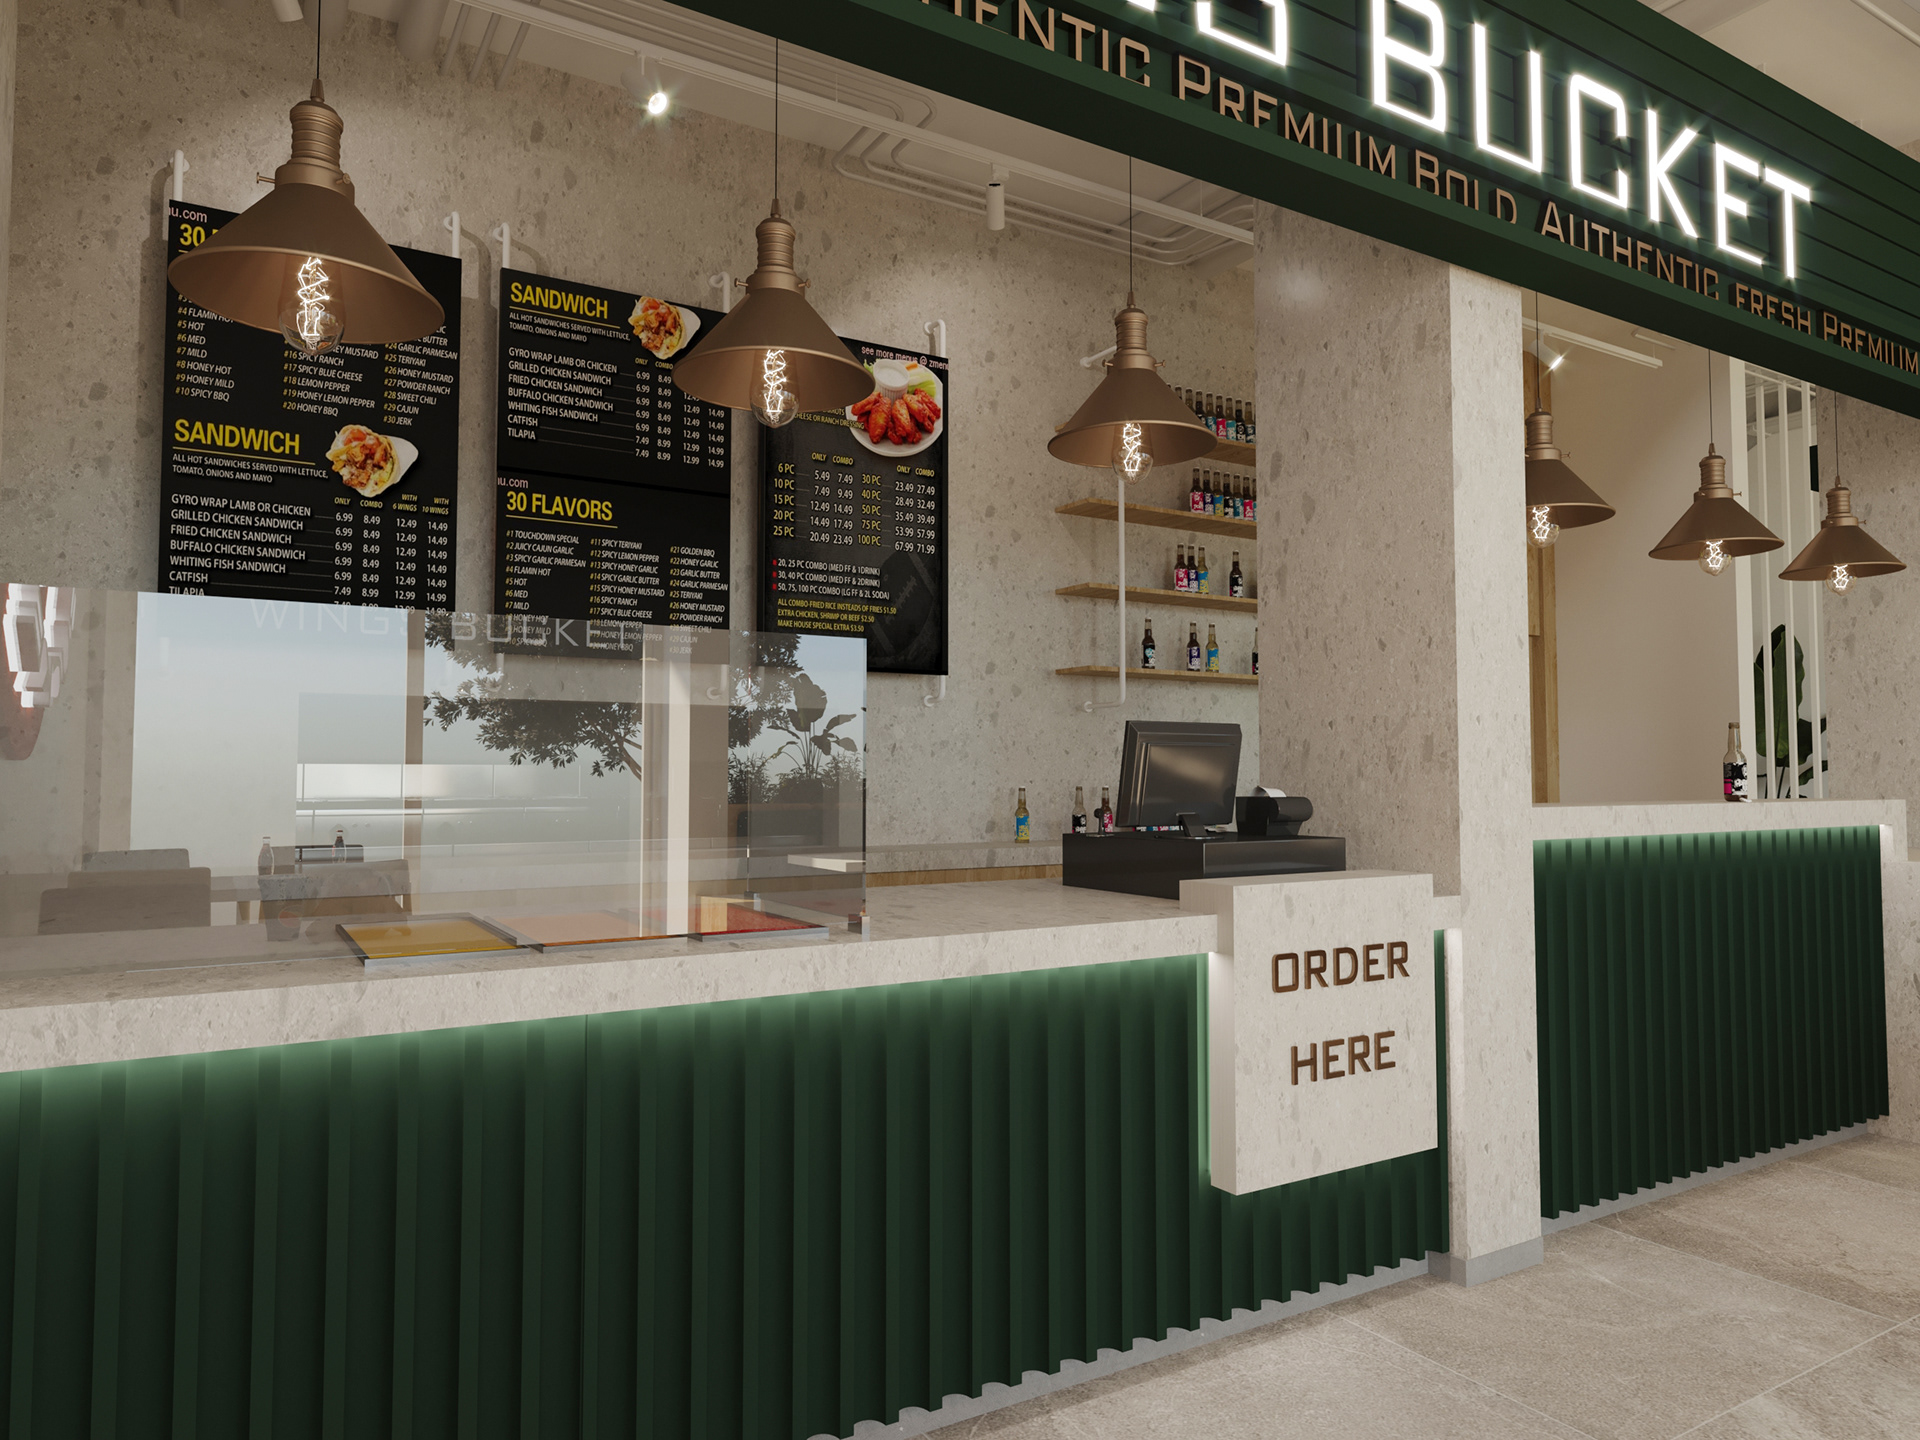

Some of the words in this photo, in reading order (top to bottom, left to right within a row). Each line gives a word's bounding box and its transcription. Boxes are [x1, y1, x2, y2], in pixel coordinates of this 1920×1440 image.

[1370, 0, 1812, 280] BUCKET
[180, 223, 206, 247] 30
[1540, 200, 1720, 301] AUTHENTIC
[1735, 281, 1812, 336] FRESH
[510, 282, 608, 319] SANDWICH
[176, 346, 187, 355] #7
[186, 347, 208, 359] MILD
[508, 346, 530, 359] GYRO
[530, 350, 553, 362] WRAP
[553, 355, 574, 366] LAMB
[575, 358, 586, 368] OR
[586, 360, 617, 373] CHICKEN
[861, 346, 875, 356] see
[876, 348, 894, 360] more
[176, 360, 186, 369] #8
[186, 361, 215, 372] HONEY
[214, 365, 232, 375] HOT
[508, 360, 540, 374] GRILLED
[540, 365, 572, 379] CHICKEN
[572, 371, 612, 385] SANDWICH
[176, 373, 186, 382] #9
[186, 374, 214, 386] HONEY
[214, 378, 235, 389] MILD
[508, 373, 530, 385] FRIED
[530, 377, 563, 391] CHICKEN
[563, 382, 603, 397] SANDWICH
[175, 387, 190, 396] #10
[190, 387, 213, 399] SPICY
[213, 391, 230, 402] BBQ
[507, 414, 538, 427] CATFISH
[174, 419, 300, 455] SANDWICH
[507, 427, 536, 440] TILAPIA
[811, 452, 827, 461] ONLY
[832, 455, 854, 466] COMBO
[778, 463, 784, 473] 6
[784, 463, 795, 475] PC
[814, 470, 830, 481] 5.49
[838, 473, 853, 484] 7.49
[896, 464, 911, 474] ONLY
[915, 467, 935, 477] COMBO
[774, 478, 784, 489] 10
[784, 479, 795, 490] PC
[814, 485, 830, 497] 7.49
[837, 488, 853, 500] 9.49
[862, 473, 871, 484] 30
[871, 475, 881, 486] PC
[895, 481, 914, 493] 23.49
[917, 484, 935, 496] 27.49
[334, 496, 351, 505] ONLY
[359, 499, 383, 509] COMBO
[397, 503, 417, 512] WINGS
[401, 494, 418, 502] WITH
[434, 497, 450, 505] WITH
[506, 490, 527, 512] 30
[532, 493, 613, 521] FLAVORS
[774, 494, 783, 504] 15
[784, 494, 795, 506] PC
[810, 500, 830, 512] 12.49
[834, 503, 853, 515] 14.49
[861, 489, 871, 499] 40
[871, 490, 881, 501] PC
[895, 496, 914, 508] 28.49
[917, 499, 935, 510] 32.49
[171, 493, 199, 506] GYRO
[199, 496, 228, 508] WRAP
[229, 499, 256, 511] LAMB
[257, 502, 271, 513] OR
[272, 503, 311, 516] CHICKEN
[335, 512, 353, 522] 6.99
[363, 514, 381, 525] 8.49
[396, 518, 417, 529] 12.49
[428, 521, 448, 532] 14.49
[429, 506, 449, 515] WINGS
[773, 509, 783, 520] 20
[784, 510, 794, 522] PC
[810, 516, 830, 528] 14.49
[834, 519, 853, 530] 17.49
[862, 504, 871, 514] 50
[871, 505, 881, 516] PC
[895, 511, 914, 522] 35.49
[917, 513, 935, 525] 39.49
[171, 508, 211, 522] GRILLED
[212, 512, 253, 526] CHICKEN
[254, 516, 303, 530] SANDWICH
[335, 526, 353, 537] 6.99
[363, 529, 380, 540] 8.49
[396, 532, 417, 543] 12.49
[427, 535, 448, 546] 14.49
[773, 525, 783, 536] 25
[784, 526, 794, 538] PC
[810, 531, 830, 543] 20.49
[833, 534, 853, 546] 23.49
[862, 519, 871, 530] 75
[871, 520, 881, 531] PC
[895, 526, 914, 537] 53.99
[916, 528, 935, 540] 57.99
[170, 524, 198, 536] FRIED
[199, 526, 241, 540] CHICKEN
[242, 530, 292, 544] SANDWICH
[335, 541, 353, 552] 6.99
[362, 544, 380, 554] 8.49
[396, 546, 417, 557] 12.49
[427, 549, 448, 560] 14.49
[858, 534, 871, 545] 100
[871, 535, 881, 546] PC
[894, 541, 914, 552] 67.99
[917, 543, 935, 555] 71.99
[170, 539, 213, 553] BUFFALO
[214, 543, 255, 556] CHICKEN
[256, 546, 306, 560] SANDWICH
[334, 556, 352, 566] 6.99
[362, 558, 380, 569] 8.49
[396, 561, 416, 572] 12.49
[427, 564, 447, 574] 14.49
[778, 558, 787, 567] 20,
[788, 559, 796, 568] 25
[796, 559, 805, 569] PC
[805, 560, 828, 571] COMBO
[828, 563, 844, 572] (MED
[844, 564, 851, 572] FF
[851, 565, 857, 574] &
[857, 566, 880, 576] 1DRINK)
[169, 555, 212, 568] WHITING
[213, 558, 234, 570] FISH
[236, 560, 286, 574] SANDWICH
[334, 571, 352, 581] 6.99
[362, 573, 380, 583] 8.49
[395, 576, 416, 586] 12.49
[427, 578, 447, 588] 14.49
[169, 570, 208, 583] CATFISH
[334, 586, 352, 596] 7.49
[361, 588, 379, 598] 8.99
[395, 590, 416, 600] 12.99
[426, 592, 447, 602] 14.99
[1272, 941, 1410, 993] ORDER
[1291, 1031, 1396, 1086] HERE
